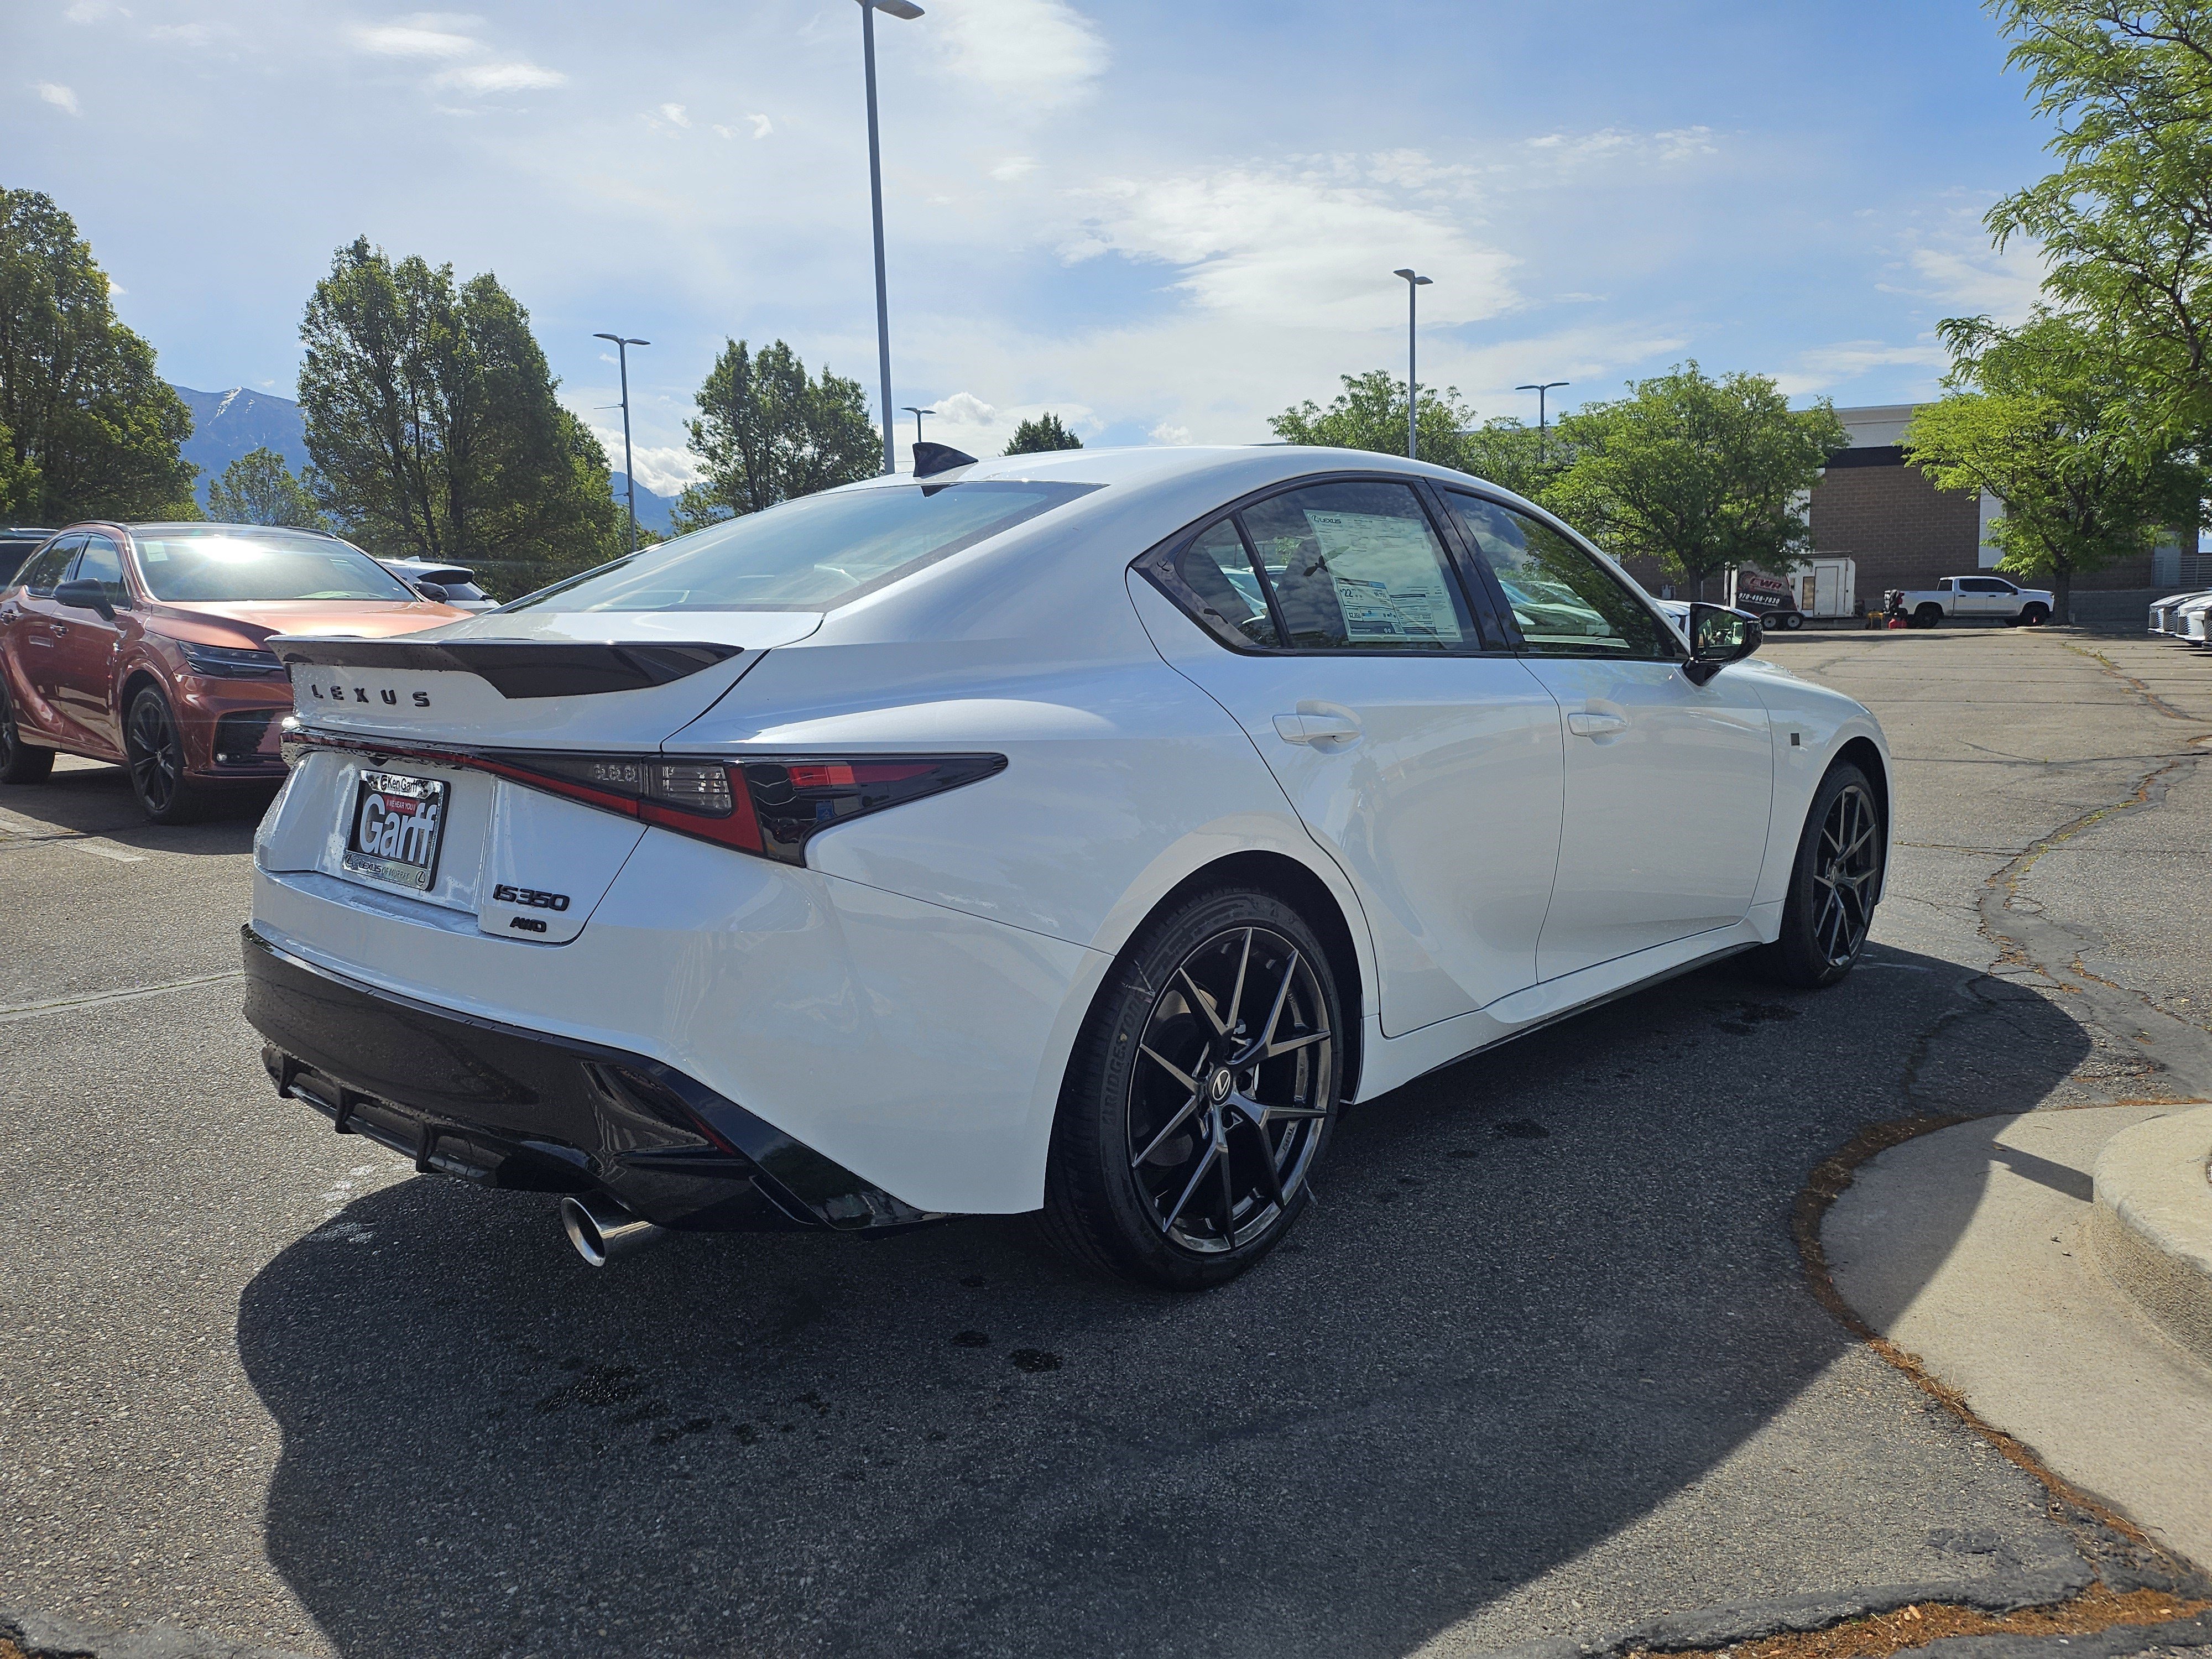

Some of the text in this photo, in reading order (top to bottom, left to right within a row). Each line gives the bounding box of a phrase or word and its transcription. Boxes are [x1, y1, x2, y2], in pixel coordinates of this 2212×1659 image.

[311, 684, 430, 707] LEXUS
[388, 776, 418, 793] Ken Garff
[359, 793, 437, 865] Garff
[358, 860, 382, 873] LEXUS
[382, 867, 389, 875] OF
[509, 916, 547, 933] AWD
